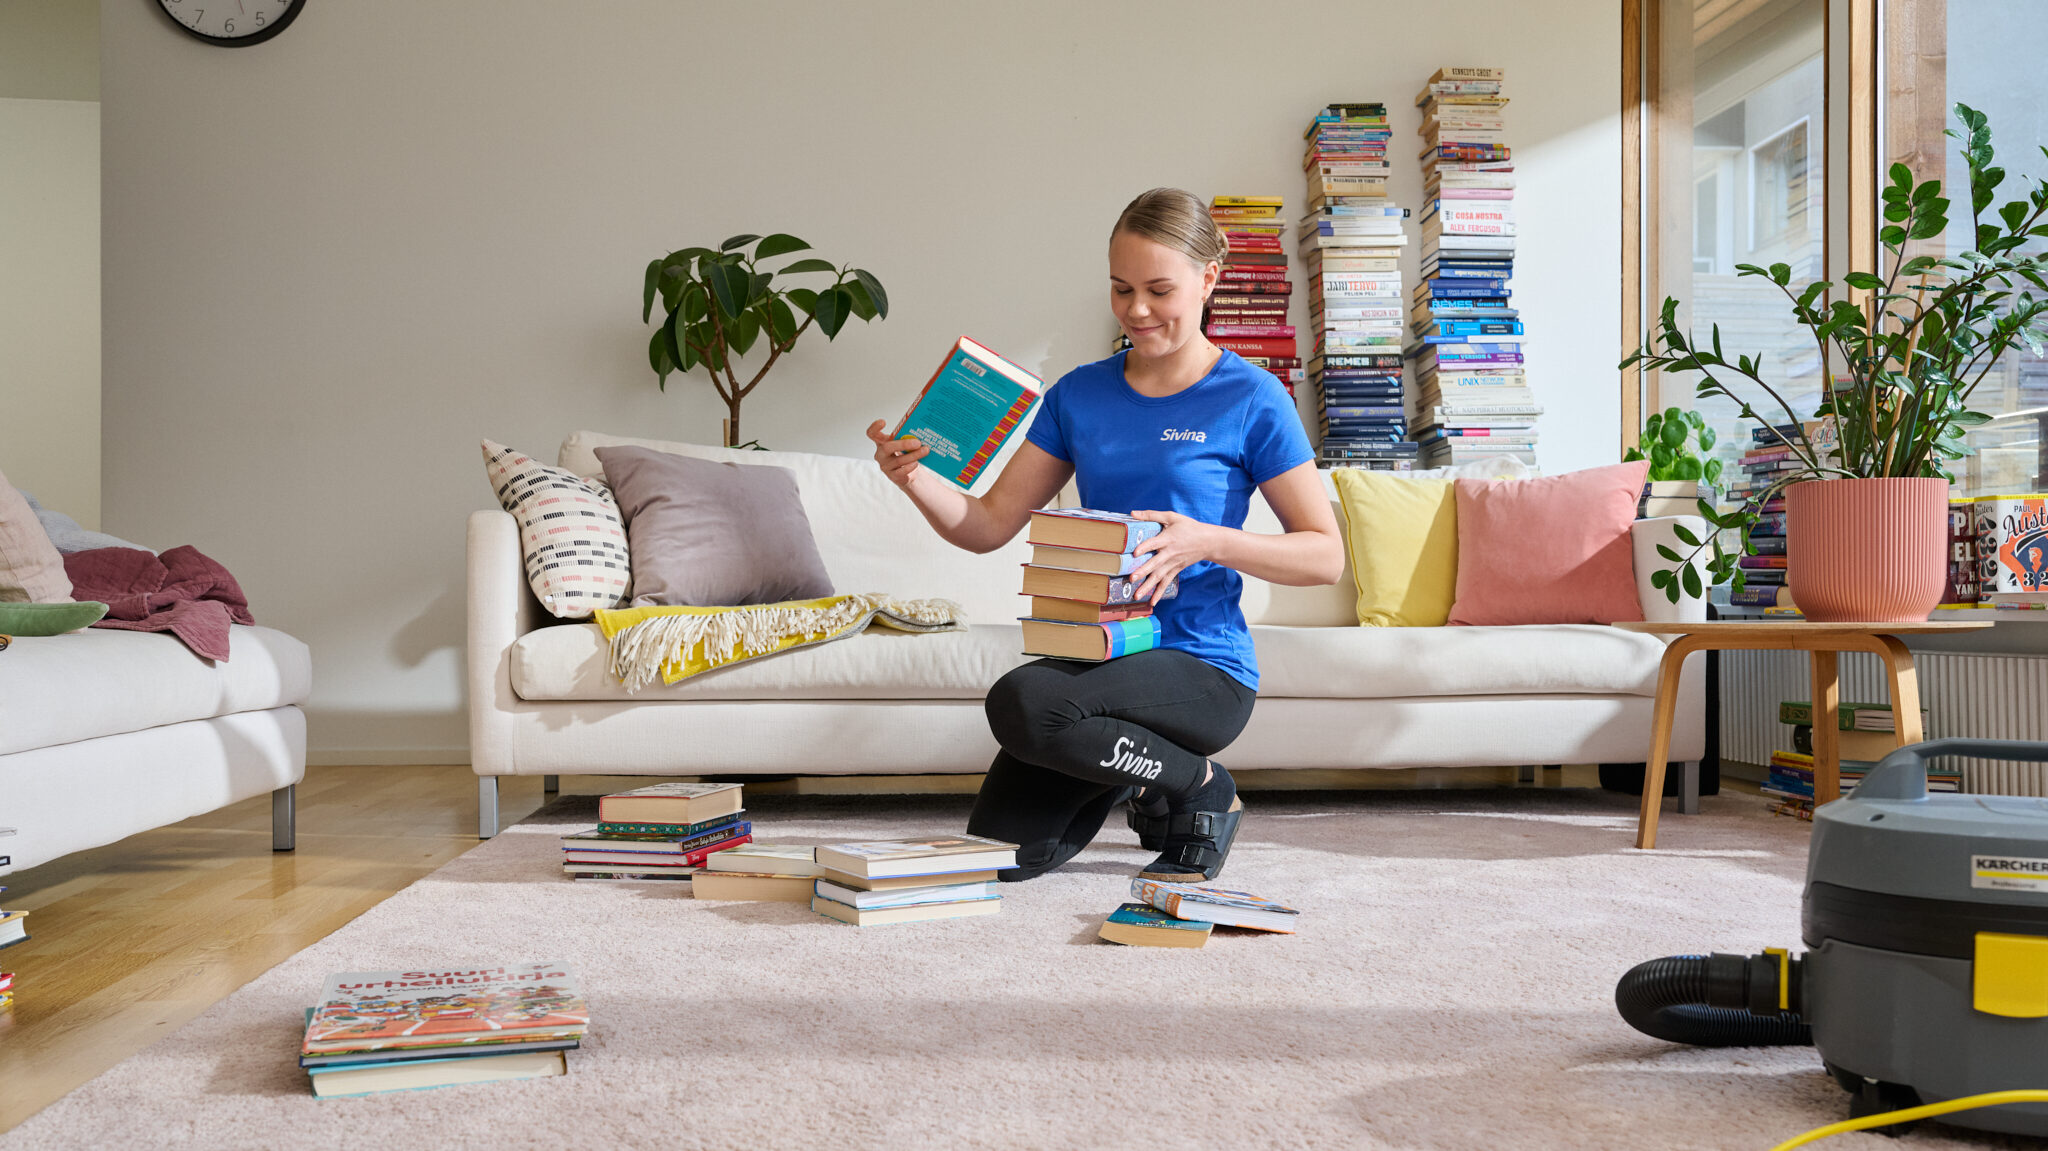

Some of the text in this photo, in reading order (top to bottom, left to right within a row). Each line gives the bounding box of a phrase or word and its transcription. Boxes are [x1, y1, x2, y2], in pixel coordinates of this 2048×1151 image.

[195, 9, 205, 24] 7
[255, 12, 265, 26] 5
[224, 18, 235, 33] 6
[1456, 212, 1503, 220] COSA NOSTRA
[1450, 224, 1500, 233] ALEX FERGUSON
[1327, 281, 1377, 291] JARI TERVO
[1214, 297, 1249, 305] REMES
[1432, 300, 1473, 308] REMES
[1458, 377, 1480, 386] UNIX
[1160, 429, 1207, 443] Sivina
[2003, 507, 2048, 543] Aust
[1100, 736, 1162, 780] Sivina
[401, 967, 504, 980] Suuri
[339, 971, 566, 990] urheilukirja
